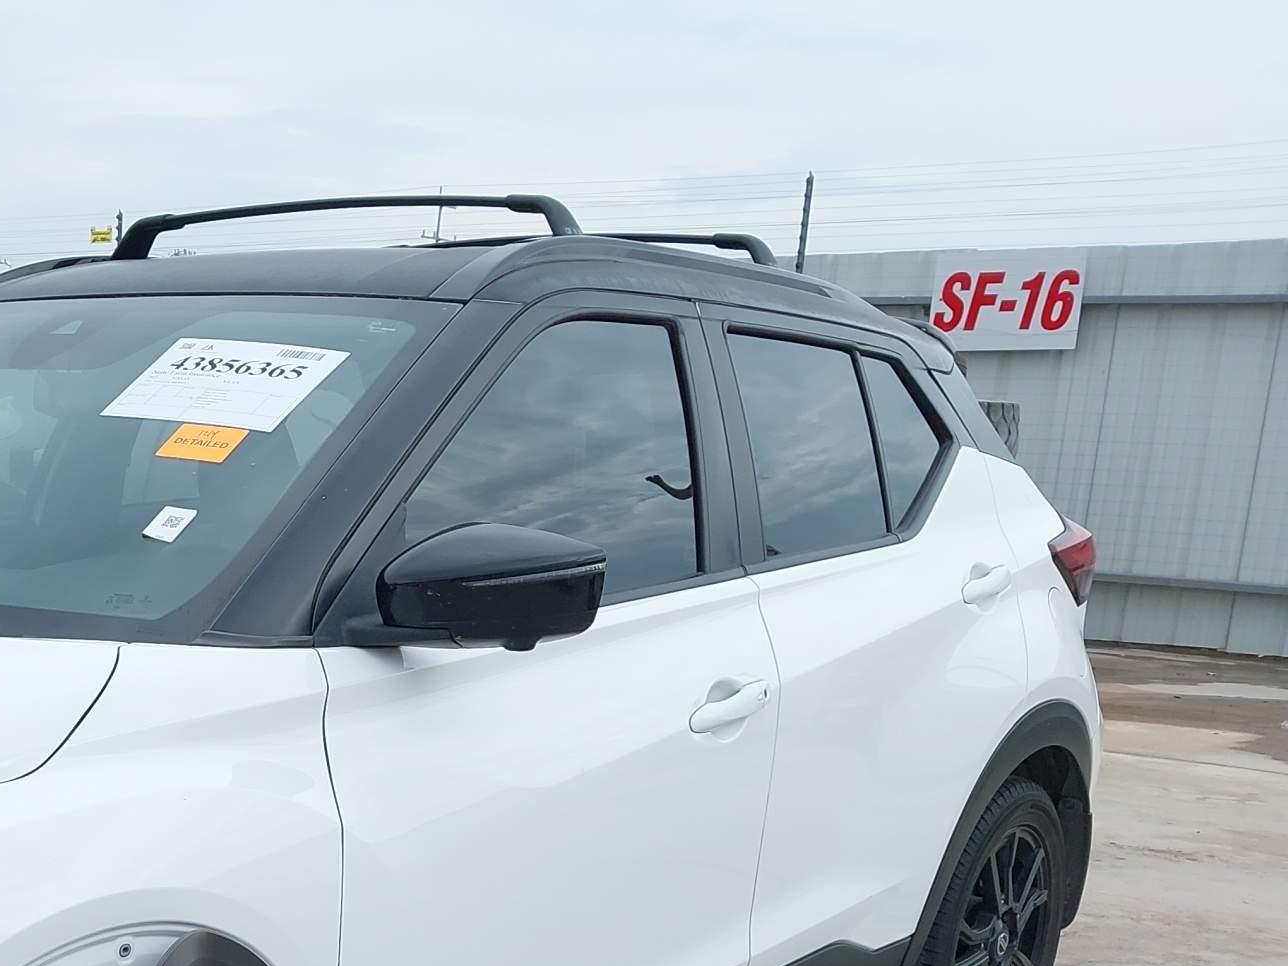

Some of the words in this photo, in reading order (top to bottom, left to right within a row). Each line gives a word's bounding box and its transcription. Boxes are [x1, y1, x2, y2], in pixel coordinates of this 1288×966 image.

[932, 268, 1081, 333] SF-16
[170, 355, 309, 381] 43856365
[173, 437, 229, 449] DETAILED
